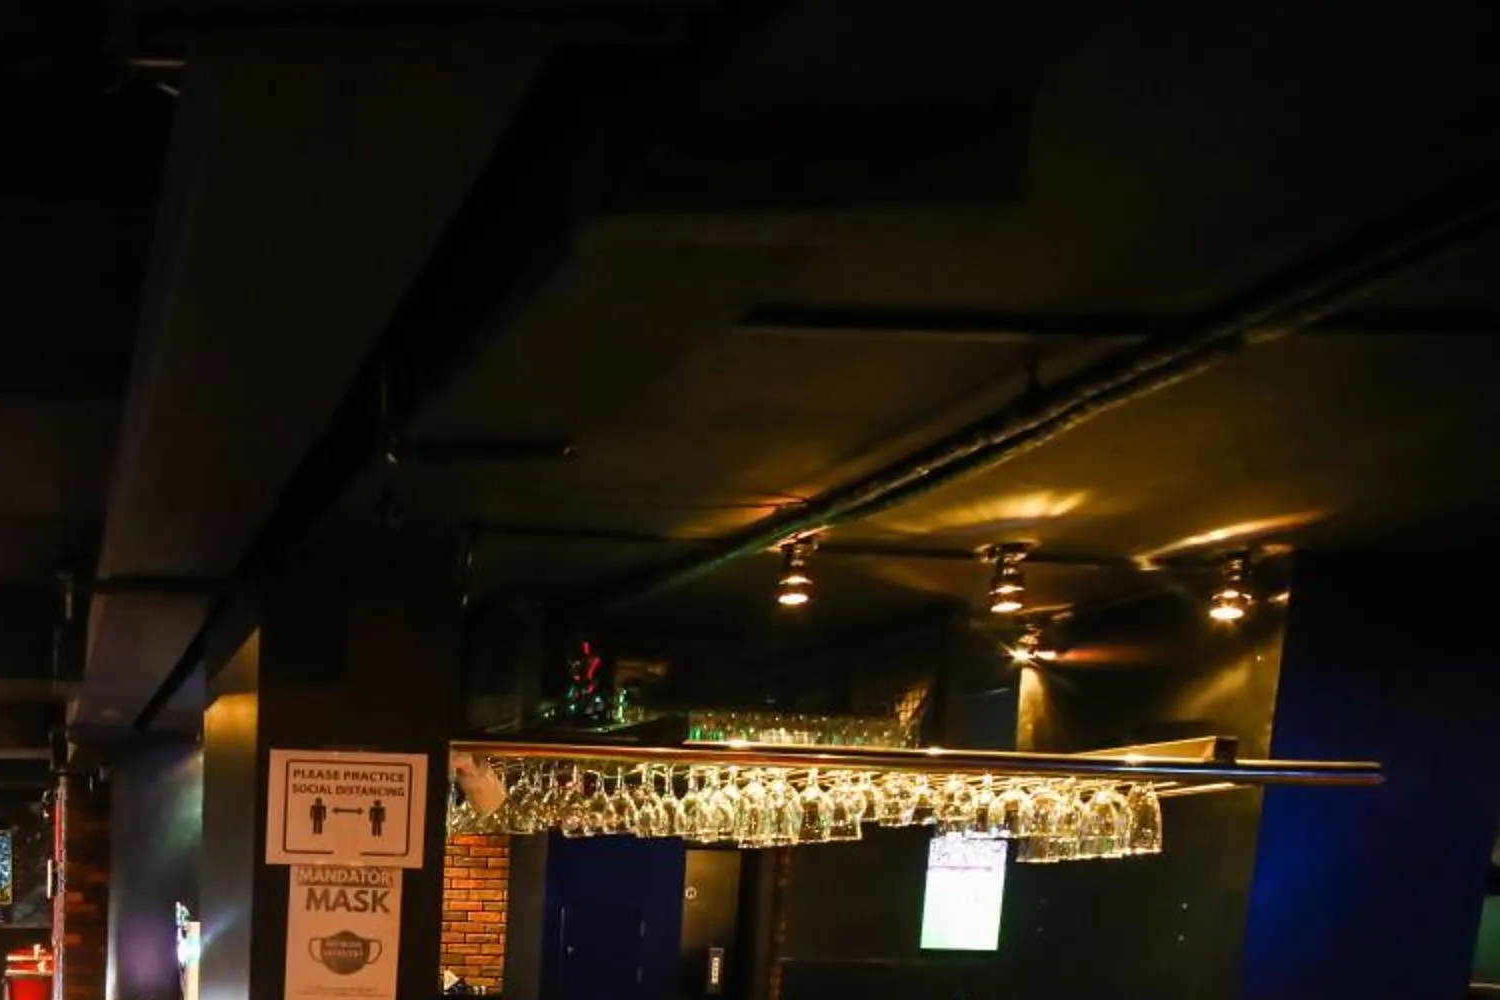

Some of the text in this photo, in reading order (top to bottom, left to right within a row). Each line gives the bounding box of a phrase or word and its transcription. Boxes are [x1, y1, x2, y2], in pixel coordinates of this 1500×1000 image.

[293, 769, 405, 783] PLEASE PRACTICE
[292, 783, 405, 797] SOCIAL DISTANCING
[298, 866, 393, 885] MANDATOR
[306, 887, 390, 913] MASK
